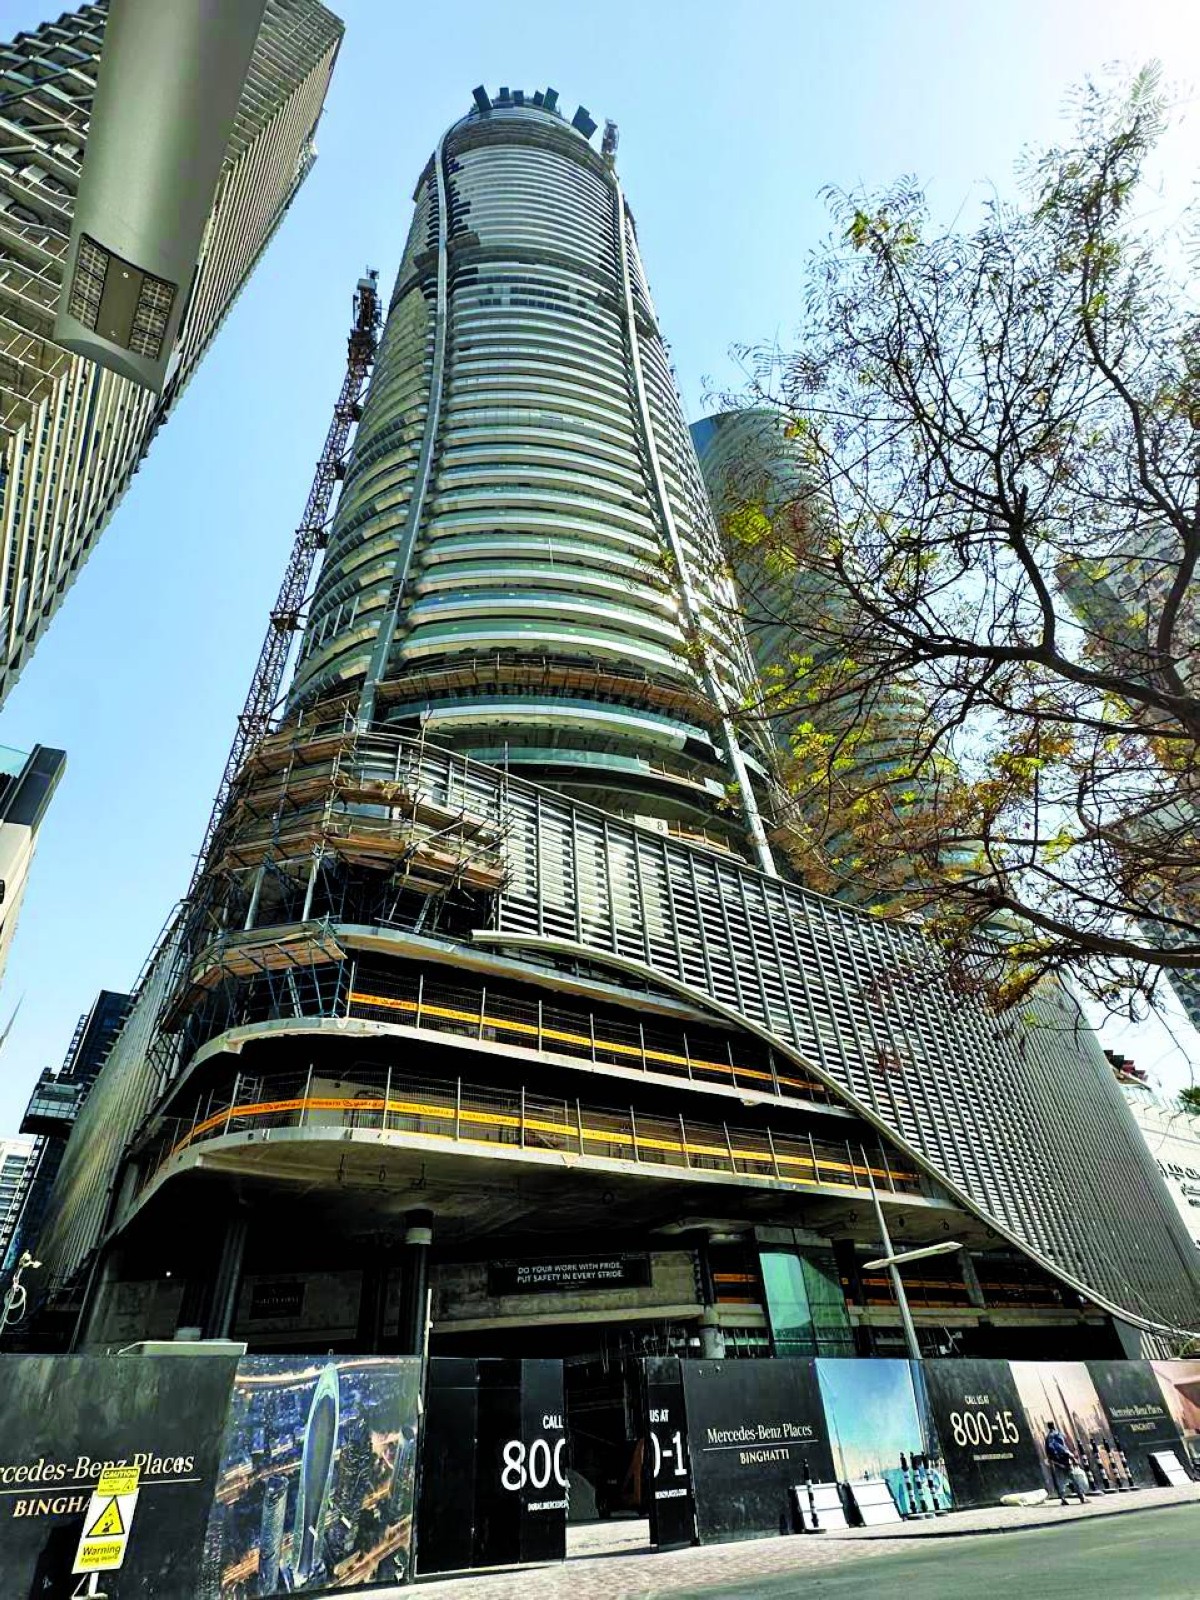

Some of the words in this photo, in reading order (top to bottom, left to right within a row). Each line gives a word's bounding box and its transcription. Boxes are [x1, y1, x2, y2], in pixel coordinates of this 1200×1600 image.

[532, 1264, 553, 1274] YOUR
[554, 1263, 578, 1273] WORK
[578, 1262, 599, 1272] WITH
[533, 1273, 561, 1283] SAFETY
[562, 1272, 571, 1281] IN
[572, 1271, 596, 1280] EVERY
[543, 1414, 564, 1429] CALL
[649, 1409, 660, 1423] US
[660, 1408, 669, 1423] AT
[707, 1425, 782, 1444] Mercedes-Benz
[782, 1422, 813, 1439] Places
[950, 1411, 1020, 1447] 800-15
[740, 1448, 790, 1465] BINGHATTI
[103, 1469, 138, 1479] CAUTION
[83, 1544, 121, 1558] Warning
